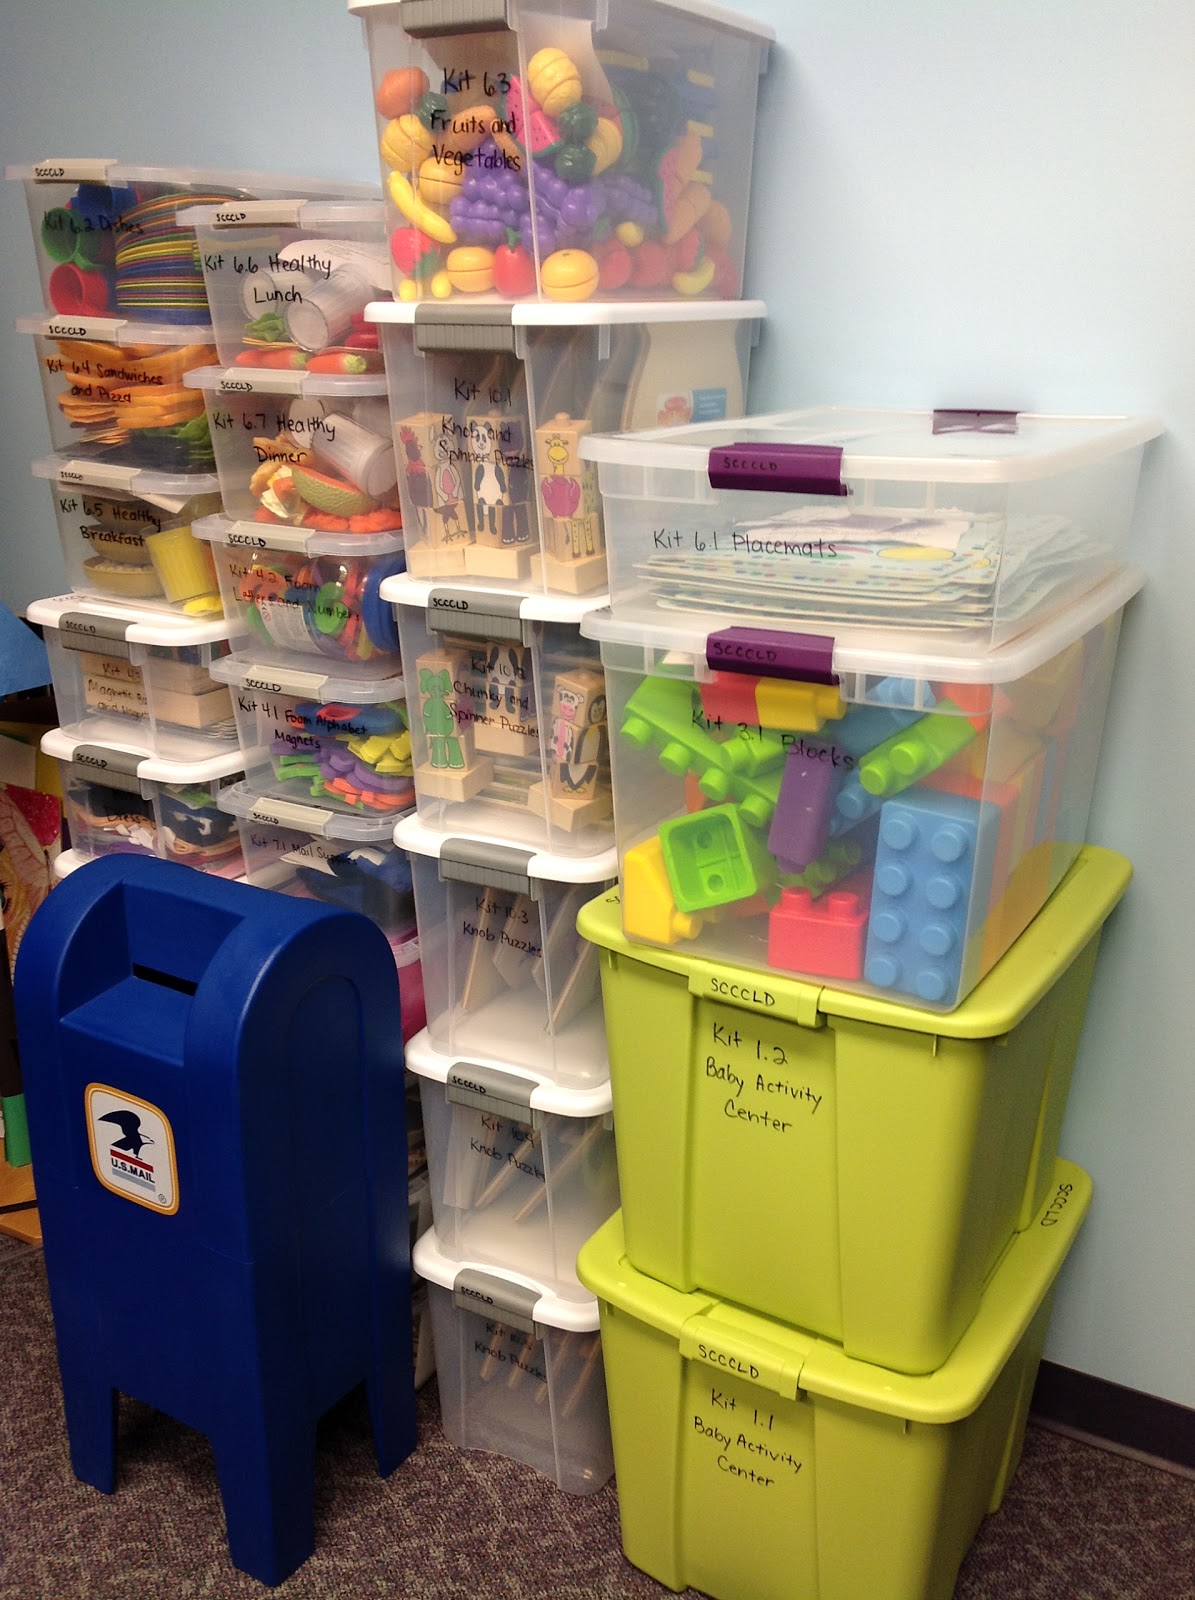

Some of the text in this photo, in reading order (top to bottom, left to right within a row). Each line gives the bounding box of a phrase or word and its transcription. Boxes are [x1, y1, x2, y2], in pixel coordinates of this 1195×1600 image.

[444, 67, 475, 94] Kit
[430, 109, 516, 134] Fruits and
[432, 143, 521, 176] Vegetables
[35, 167, 65, 177] SCCCLD
[44, 210, 63, 231] Kit
[99, 214, 144, 234] Dishes
[216, 213, 246, 222] SCCCLD
[204, 253, 331, 280] Kit 6.6 Healthy
[254, 285, 303, 304] Lunch
[49, 325, 86, 336] SCCCLD
[46, 358, 64, 374] Kit
[96, 363, 163, 386] Sandwiches
[71, 384, 131, 403] and Pizza
[220, 380, 253, 392] SCCCLD
[454, 377, 480, 401] Kit
[212, 412, 336, 442] Kit 6.7 Healthy
[442, 415, 511, 444] Knob and
[253, 445, 307, 463] Dinner
[438, 439, 490, 465] Spinner
[723, 456, 778, 471] SCCCLD
[60, 498, 161, 533] Kit 6.5 Healthy
[79, 525, 146, 547] Breakfast
[228, 533, 266, 548] SCCCLD
[653, 528, 837, 558] Kit 6.1 Placemats
[229, 564, 248, 578] Kit
[284, 574, 320, 592] Foam
[432, 597, 469, 611] SCCCLD
[66, 621, 96, 634] SCCCLD
[713, 641, 777, 662] SCCCLD
[102, 662, 120, 676] Kit
[471, 657, 495, 674] Kit
[88, 678, 134, 702] Magnetic
[245, 678, 281, 692] SCCCLD
[453, 680, 529, 710] Chunky and
[237, 696, 258, 712] Kit
[284, 709, 311, 725] Foam
[316, 714, 367, 734] Alphabet
[449, 702, 539, 737] Spinner Puzzles
[692, 709, 763, 743] Kit 3.1
[274, 728, 321, 749] Magnets
[76, 753, 108, 768] SCCCLD
[781, 734, 854, 770] Blocks
[250, 834, 267, 848] Kit
[292, 843, 314, 858] Mail
[475, 897, 529, 924] Kit 10.3
[463, 921, 542, 958] Knob Puzzles
[711, 977, 776, 1006] SCCCLD
[713, 1022, 788, 1065] Kit 1.2
[452, 1075, 487, 1094] SCCCLD
[706, 1056, 822, 1115] Baby Activity
[481, 1115, 503, 1131] Kit
[724, 1098, 793, 1133] Center
[470, 1137, 502, 1161] Knob
[1041, 1183, 1073, 1227] SCCCLD
[460, 1286, 494, 1305] SCCCLD
[485, 1323, 504, 1337] Kit
[474, 1340, 506, 1361] Knob
[698, 1343, 760, 1380] SCCCLD
[711, 1387, 774, 1431] Kit 1.1
[694, 1415, 802, 1474] Baby Activity
[717, 1454, 775, 1487] Center
